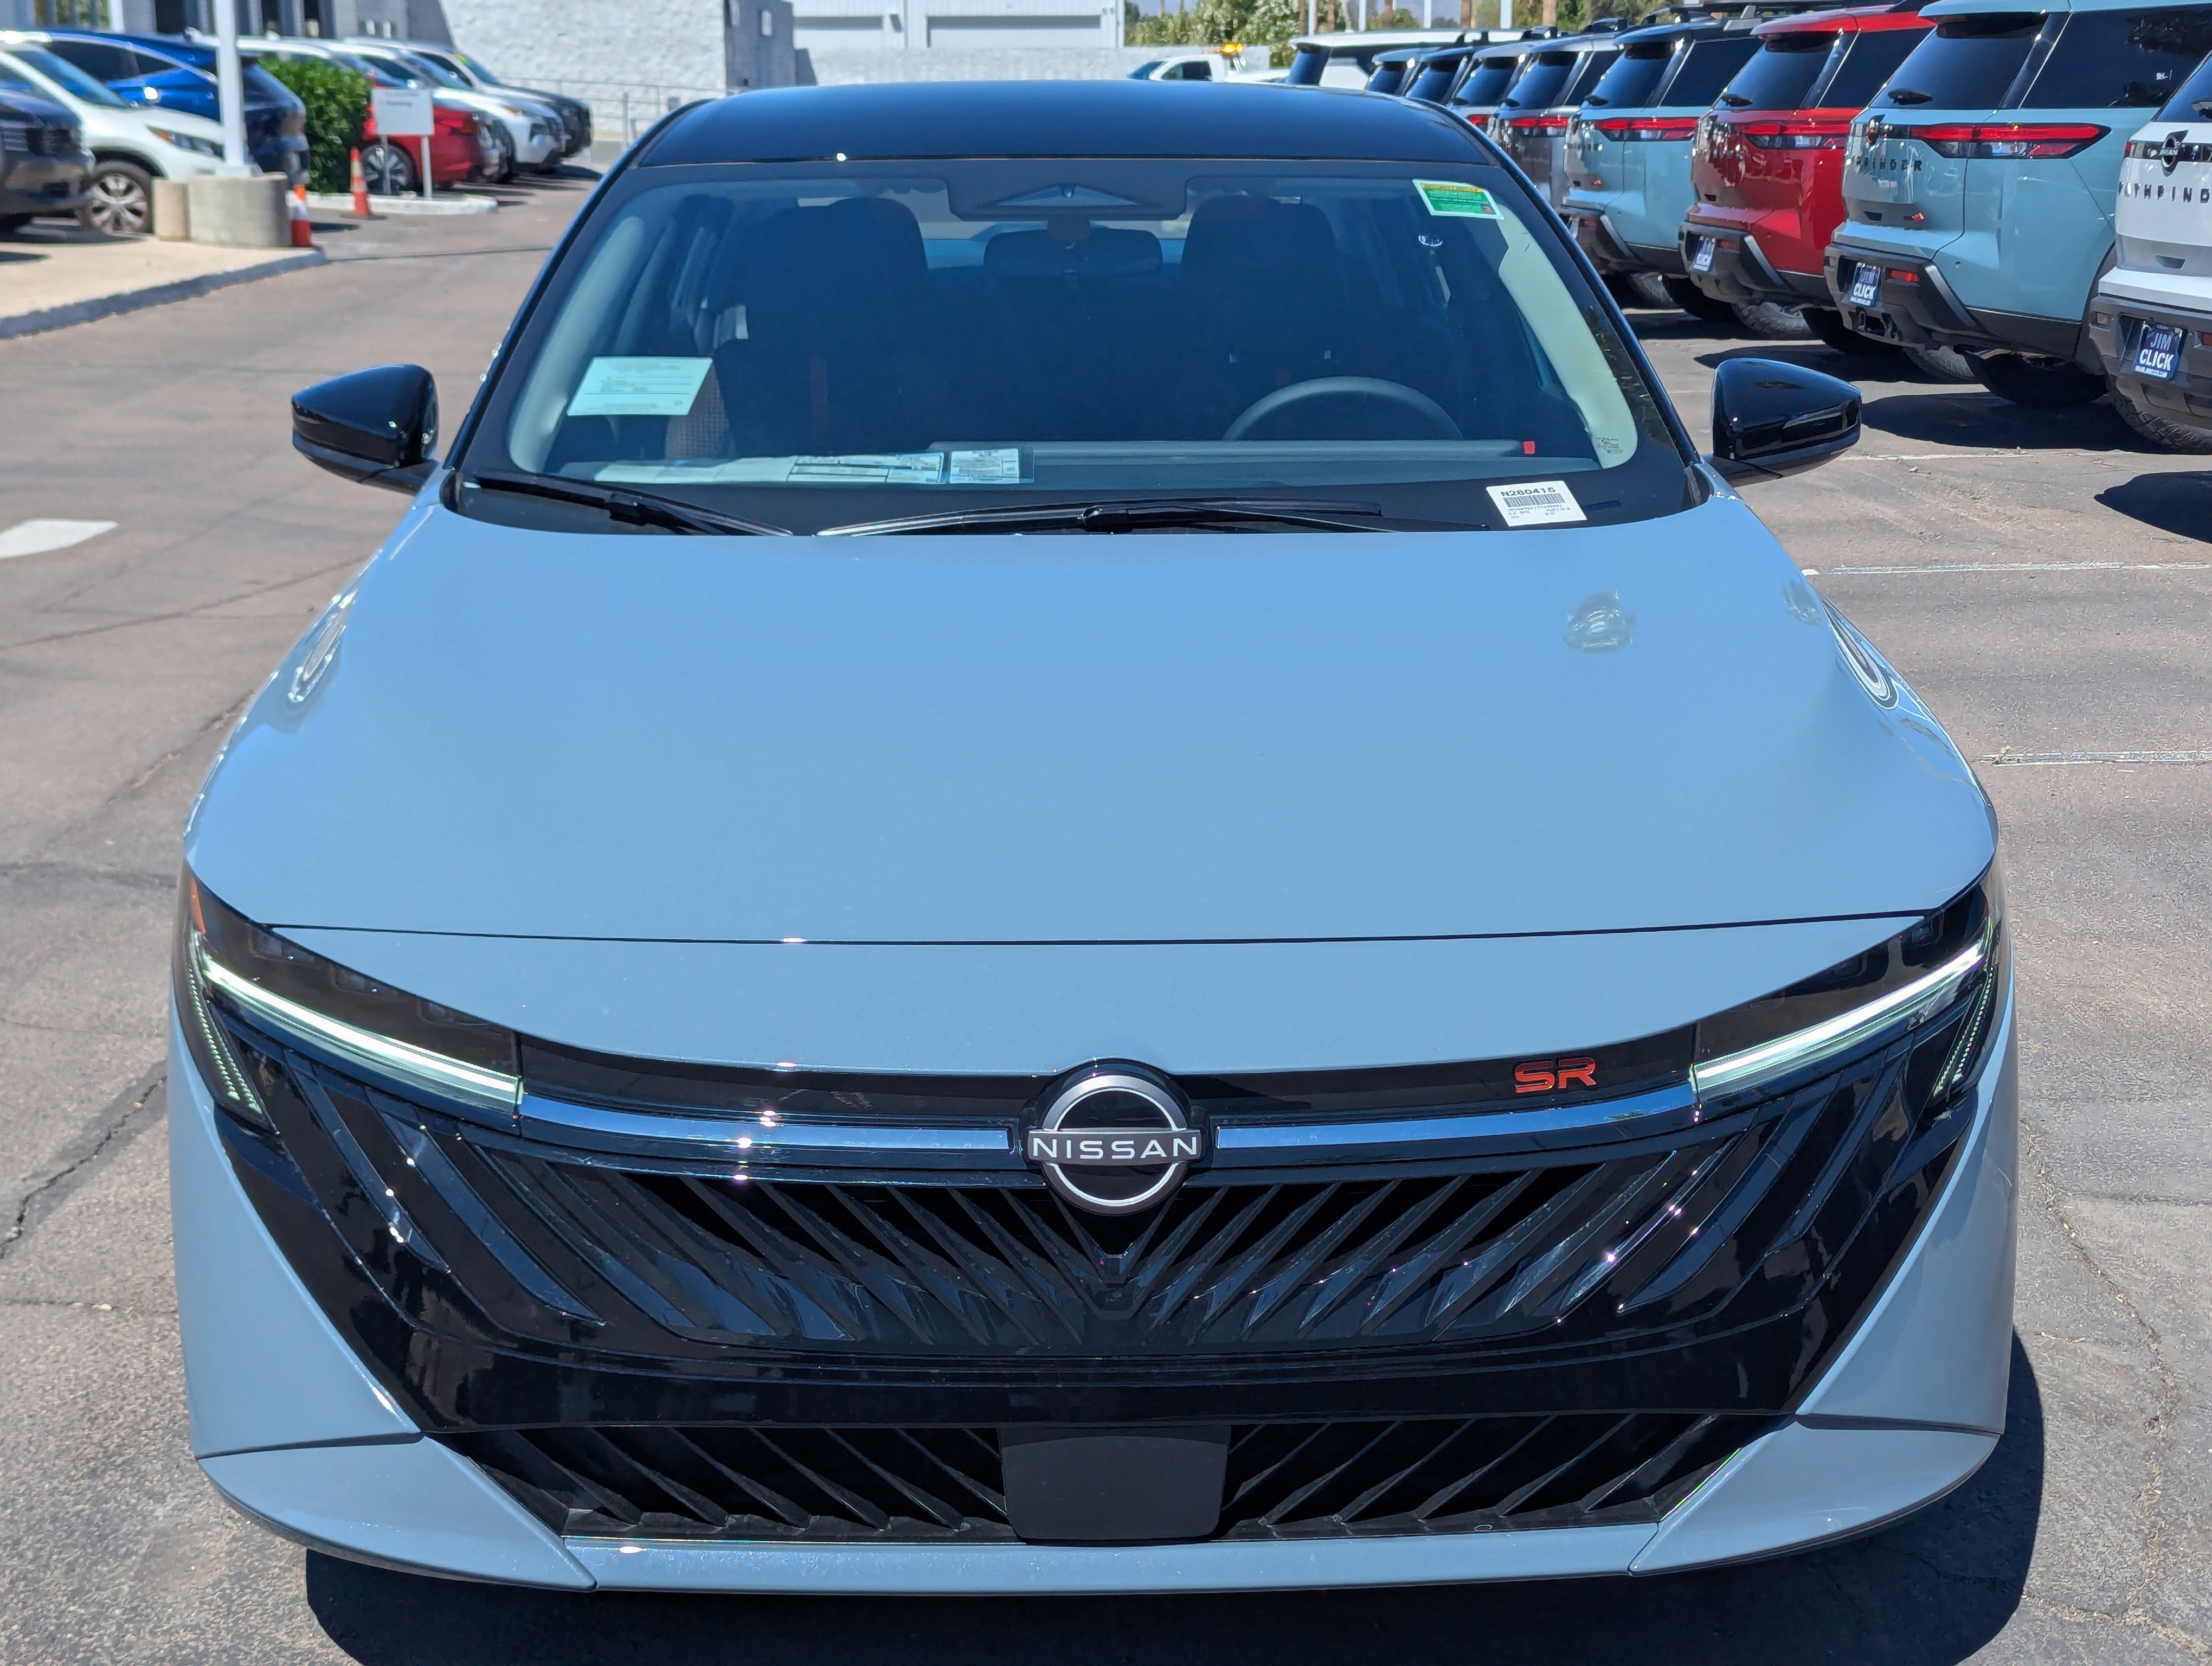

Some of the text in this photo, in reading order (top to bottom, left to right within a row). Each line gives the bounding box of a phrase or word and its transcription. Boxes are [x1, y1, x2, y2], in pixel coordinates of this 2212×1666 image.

[2150, 332, 2172, 351] JIM
[2139, 349, 2175, 371] CLICK
[1514, 1057, 1597, 1093] SR
[1032, 1136, 1197, 1159] NISSAN
